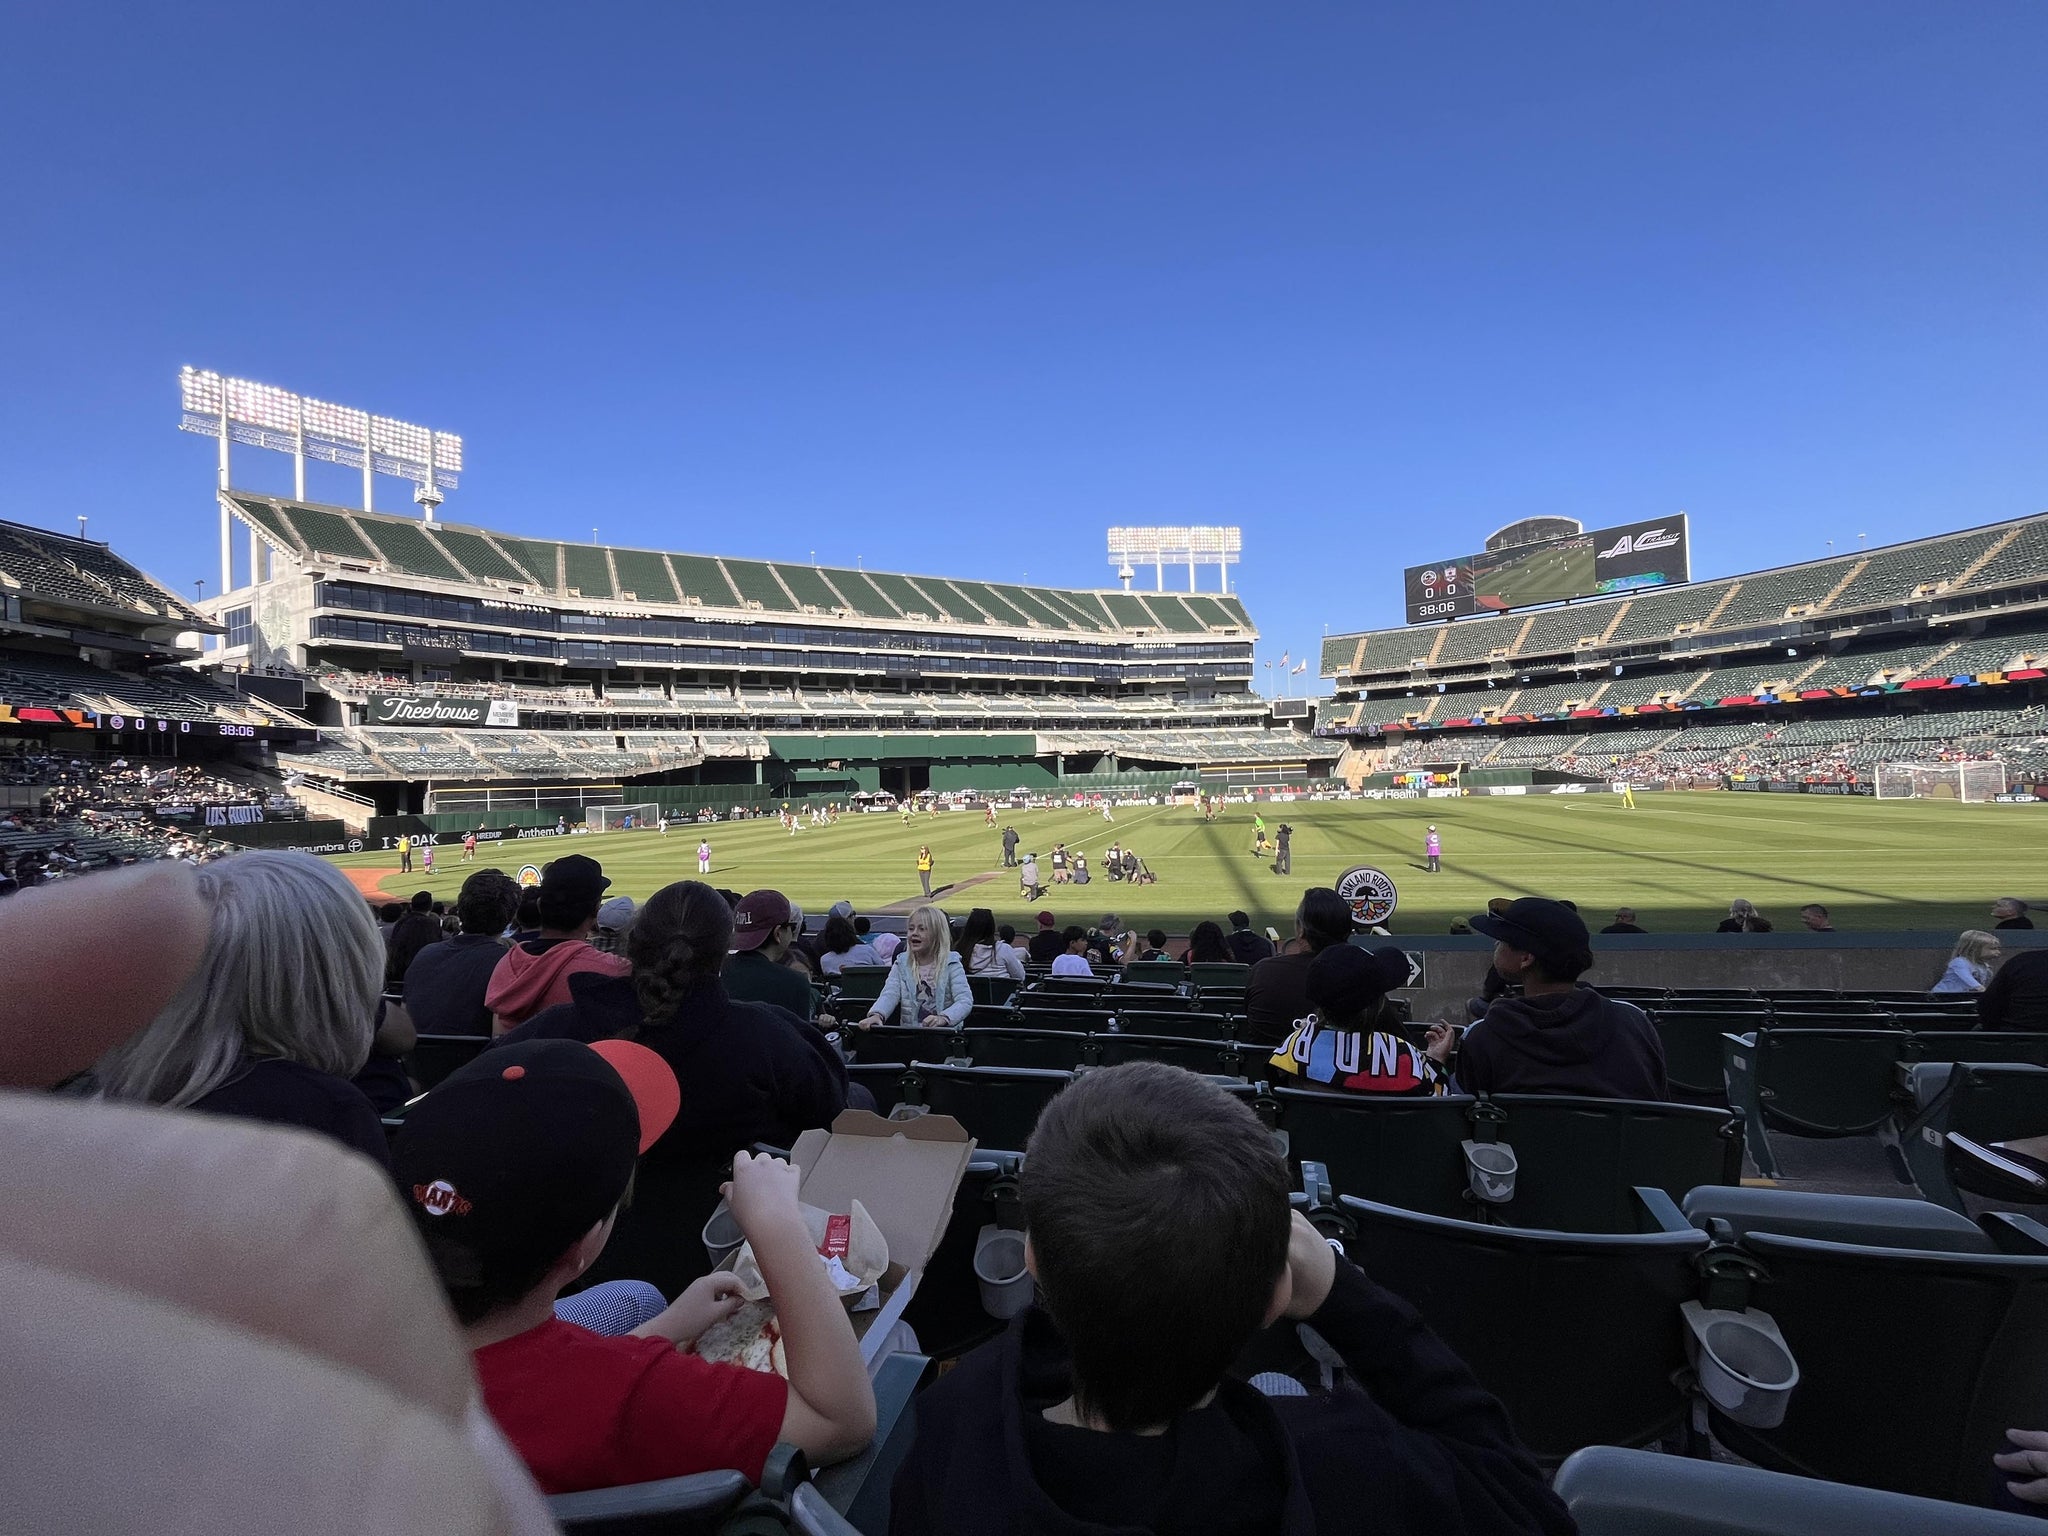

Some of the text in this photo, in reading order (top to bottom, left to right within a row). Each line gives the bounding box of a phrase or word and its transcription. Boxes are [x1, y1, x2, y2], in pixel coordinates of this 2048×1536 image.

[1597, 528, 1680, 558] AC
[1645, 532, 1680, 544] TRANSIT
[1425, 584, 1456, 599] 0 0
[1419, 602, 1456, 616] 38:06
[378, 697, 480, 721] Treehouse
[135, 718, 255, 737] 0 0 38:06
[1385, 789, 1419, 799] Health
[1808, 783, 1840, 795] Anthem
[205, 805, 264, 826] LOS ROOTS
[517, 827, 555, 838] Anthem
[381, 833, 440, 849] I OAK
[1341, 873, 1393, 898] OAKLAND ROOTS
